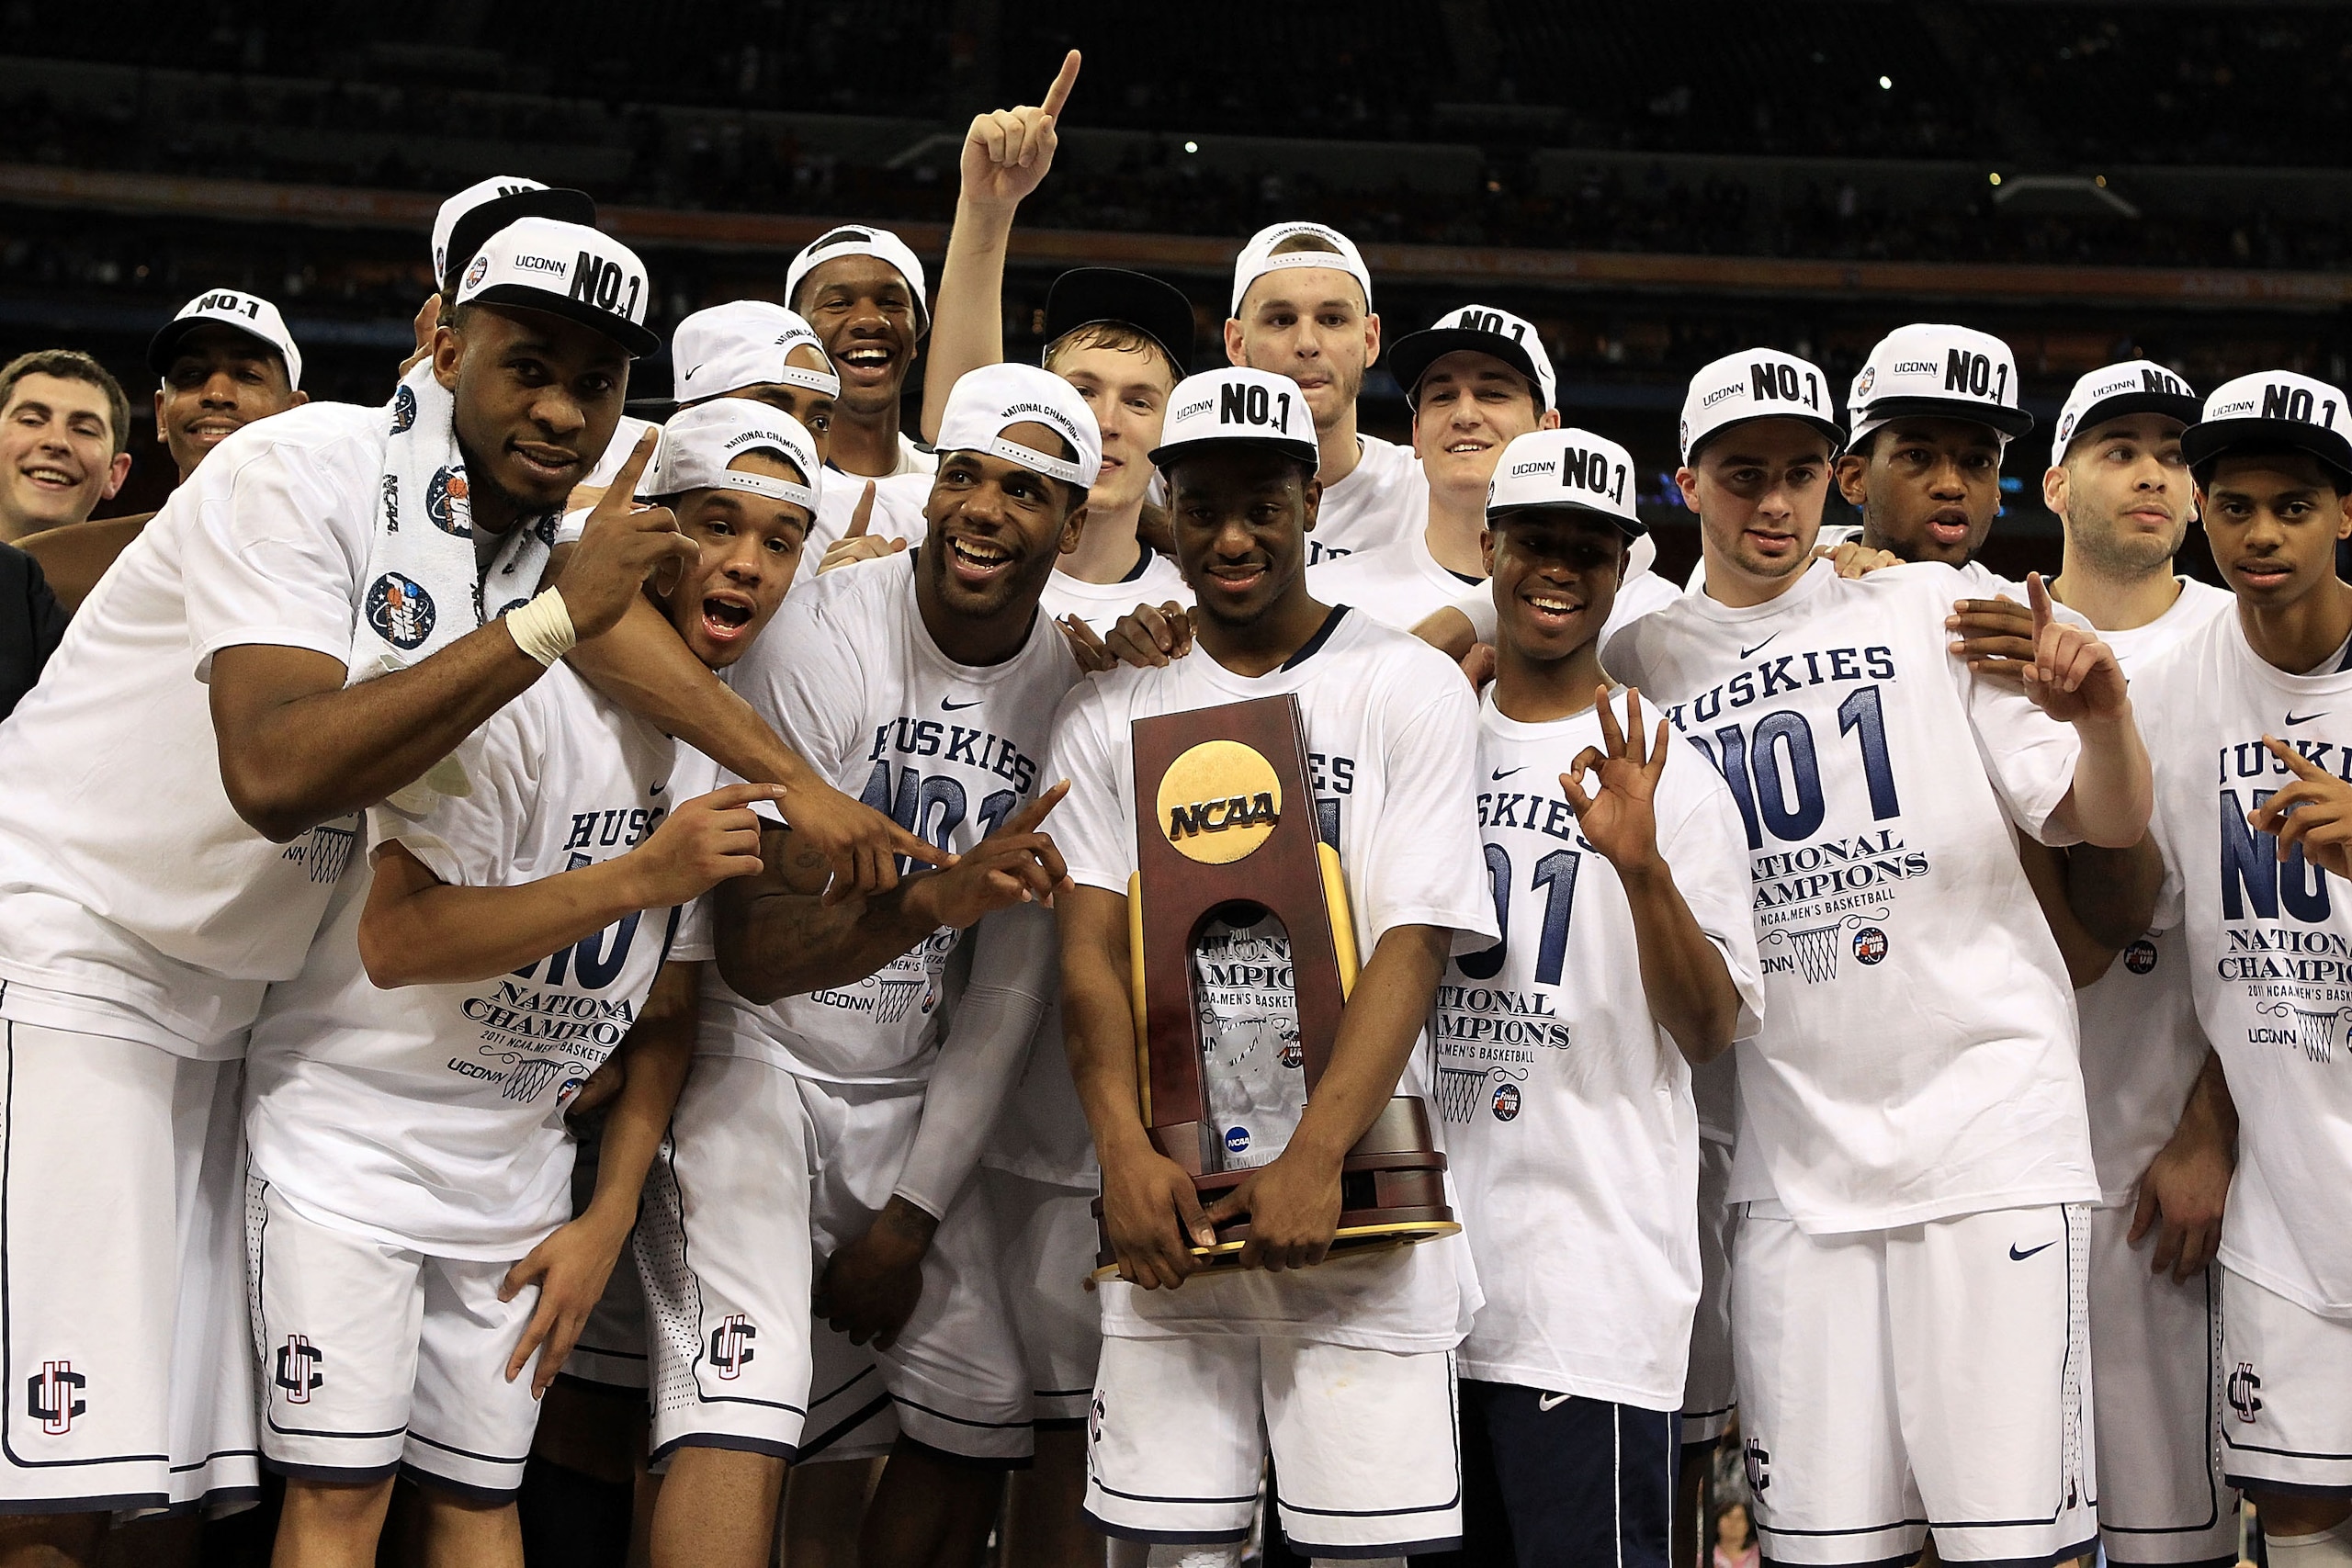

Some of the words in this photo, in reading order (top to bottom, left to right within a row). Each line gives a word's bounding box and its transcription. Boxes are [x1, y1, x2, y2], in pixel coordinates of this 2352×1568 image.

[515, 254, 567, 276] UCONN
[1894, 362, 1938, 376] UCONN
[1702, 382, 1745, 407] UCONN
[2092, 379, 2136, 398] UCONN
[1001, 402, 1043, 418] NATIONAL
[1176, 399, 1214, 421] UCONN
[2211, 400, 2255, 418] UCONN
[724, 430, 765, 450] NATIONAL
[766, 431, 808, 467] CHAMPIONS
[1512, 461, 1556, 476] UCONN
[401, 596, 417, 642] FINAL
[1838, 683, 1901, 822] 1
[1170, 791, 1281, 841] NCAA
[1826, 888, 1895, 914] BASKETBALL
[1530, 849, 1582, 987] 1
[1861, 934, 1883, 945] FINAL
[481, 1030, 506, 1044] 2011
[1479, 1048, 1534, 1064] BASKETBALL
[447, 1057, 509, 1084] UCONN
[1500, 1091, 1519, 1101] FINAL
[1227, 1136, 1250, 1147] NCAA
